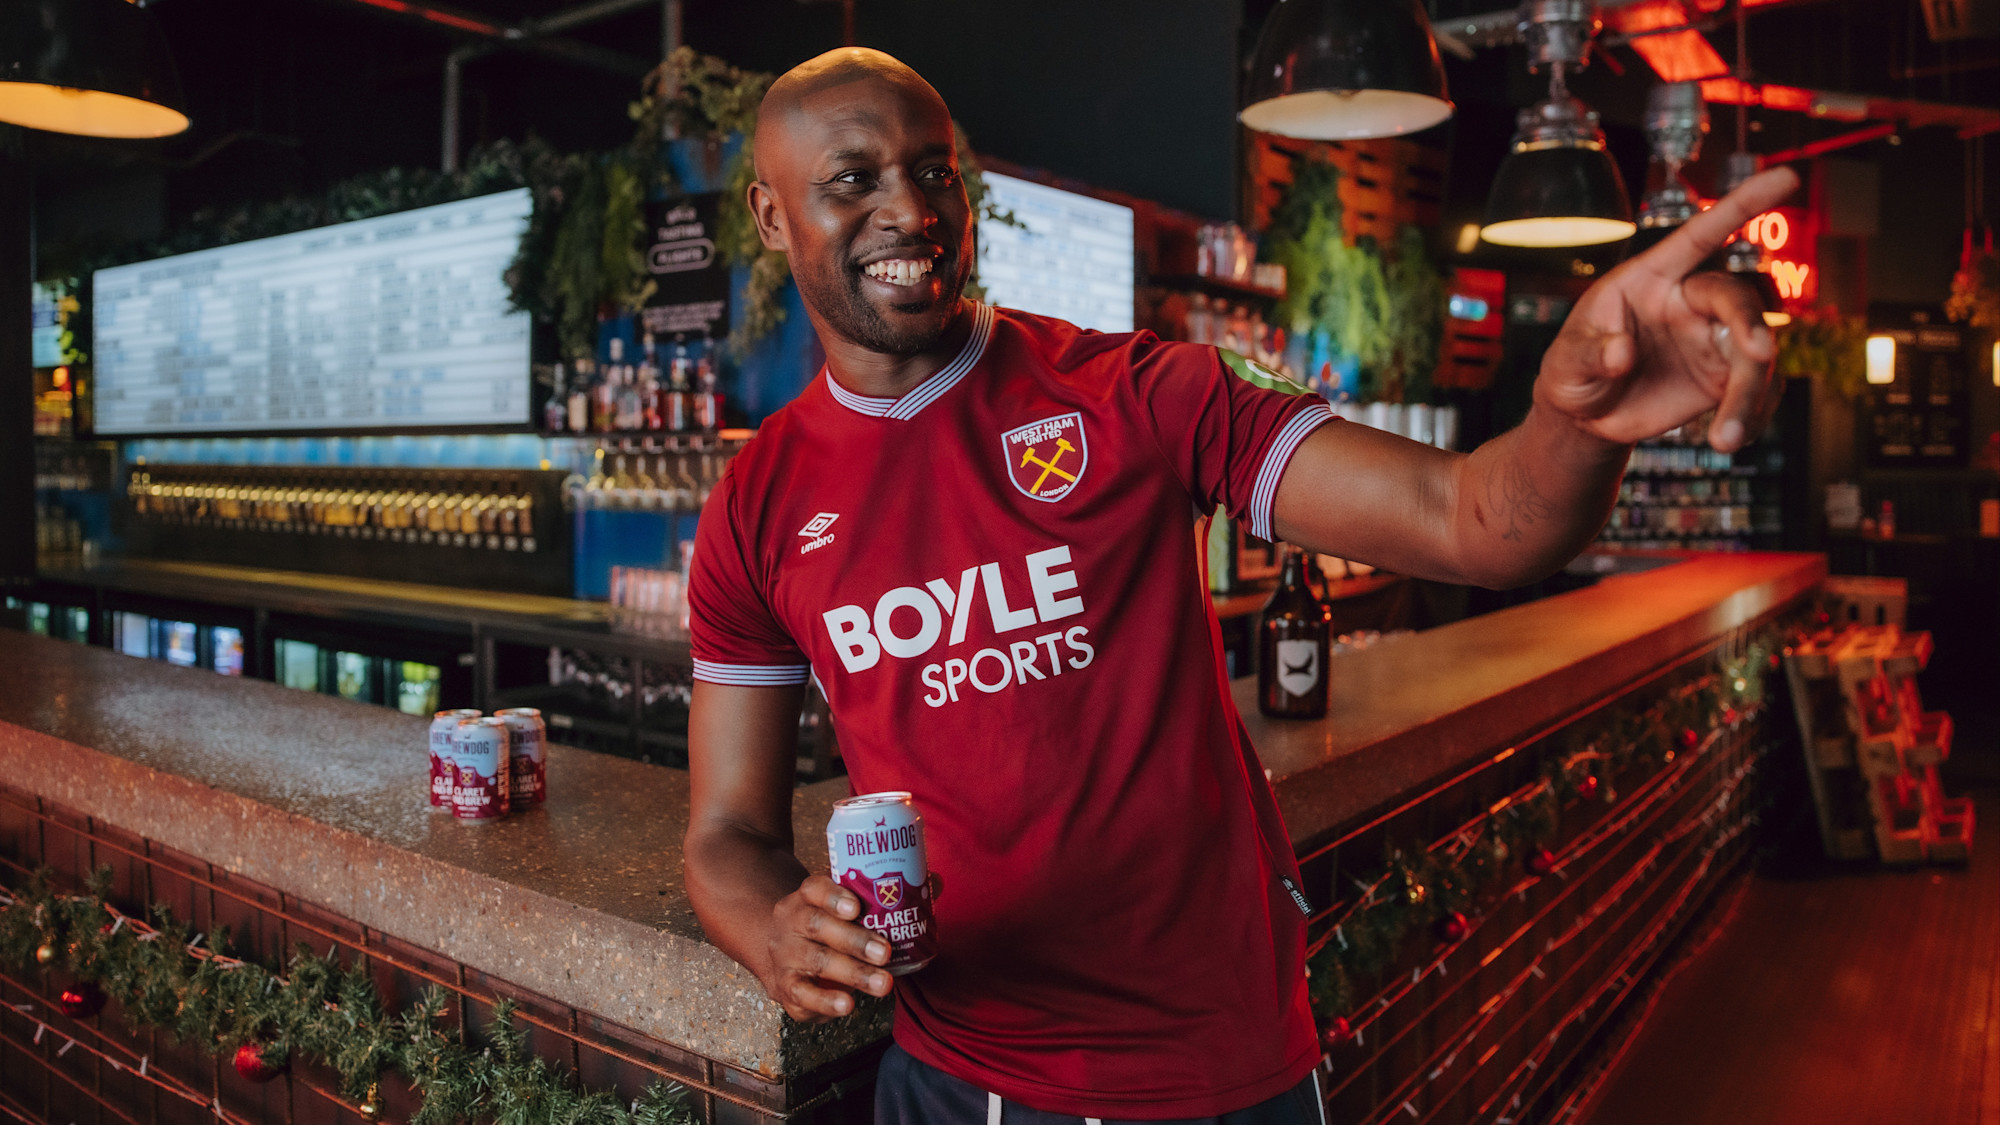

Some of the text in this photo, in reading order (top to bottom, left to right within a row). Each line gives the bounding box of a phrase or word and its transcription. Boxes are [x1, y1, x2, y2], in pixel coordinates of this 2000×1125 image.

[1010, 417, 1074, 444] WEST HAM
[1024, 429, 1062, 447] UNITED
[1039, 483, 1069, 497] LONDON
[800, 532, 835, 555] umbro
[822, 544, 1085, 674] BOYLE
[921, 625, 1095, 708] SPORTS
[454, 786, 485, 798] CLARET
[465, 795, 491, 806] BREW
[846, 824, 917, 856] BREWDOG
[1292, 889, 1312, 914] official
[863, 906, 919, 930] CLARET
[890, 919, 927, 942] BREW
